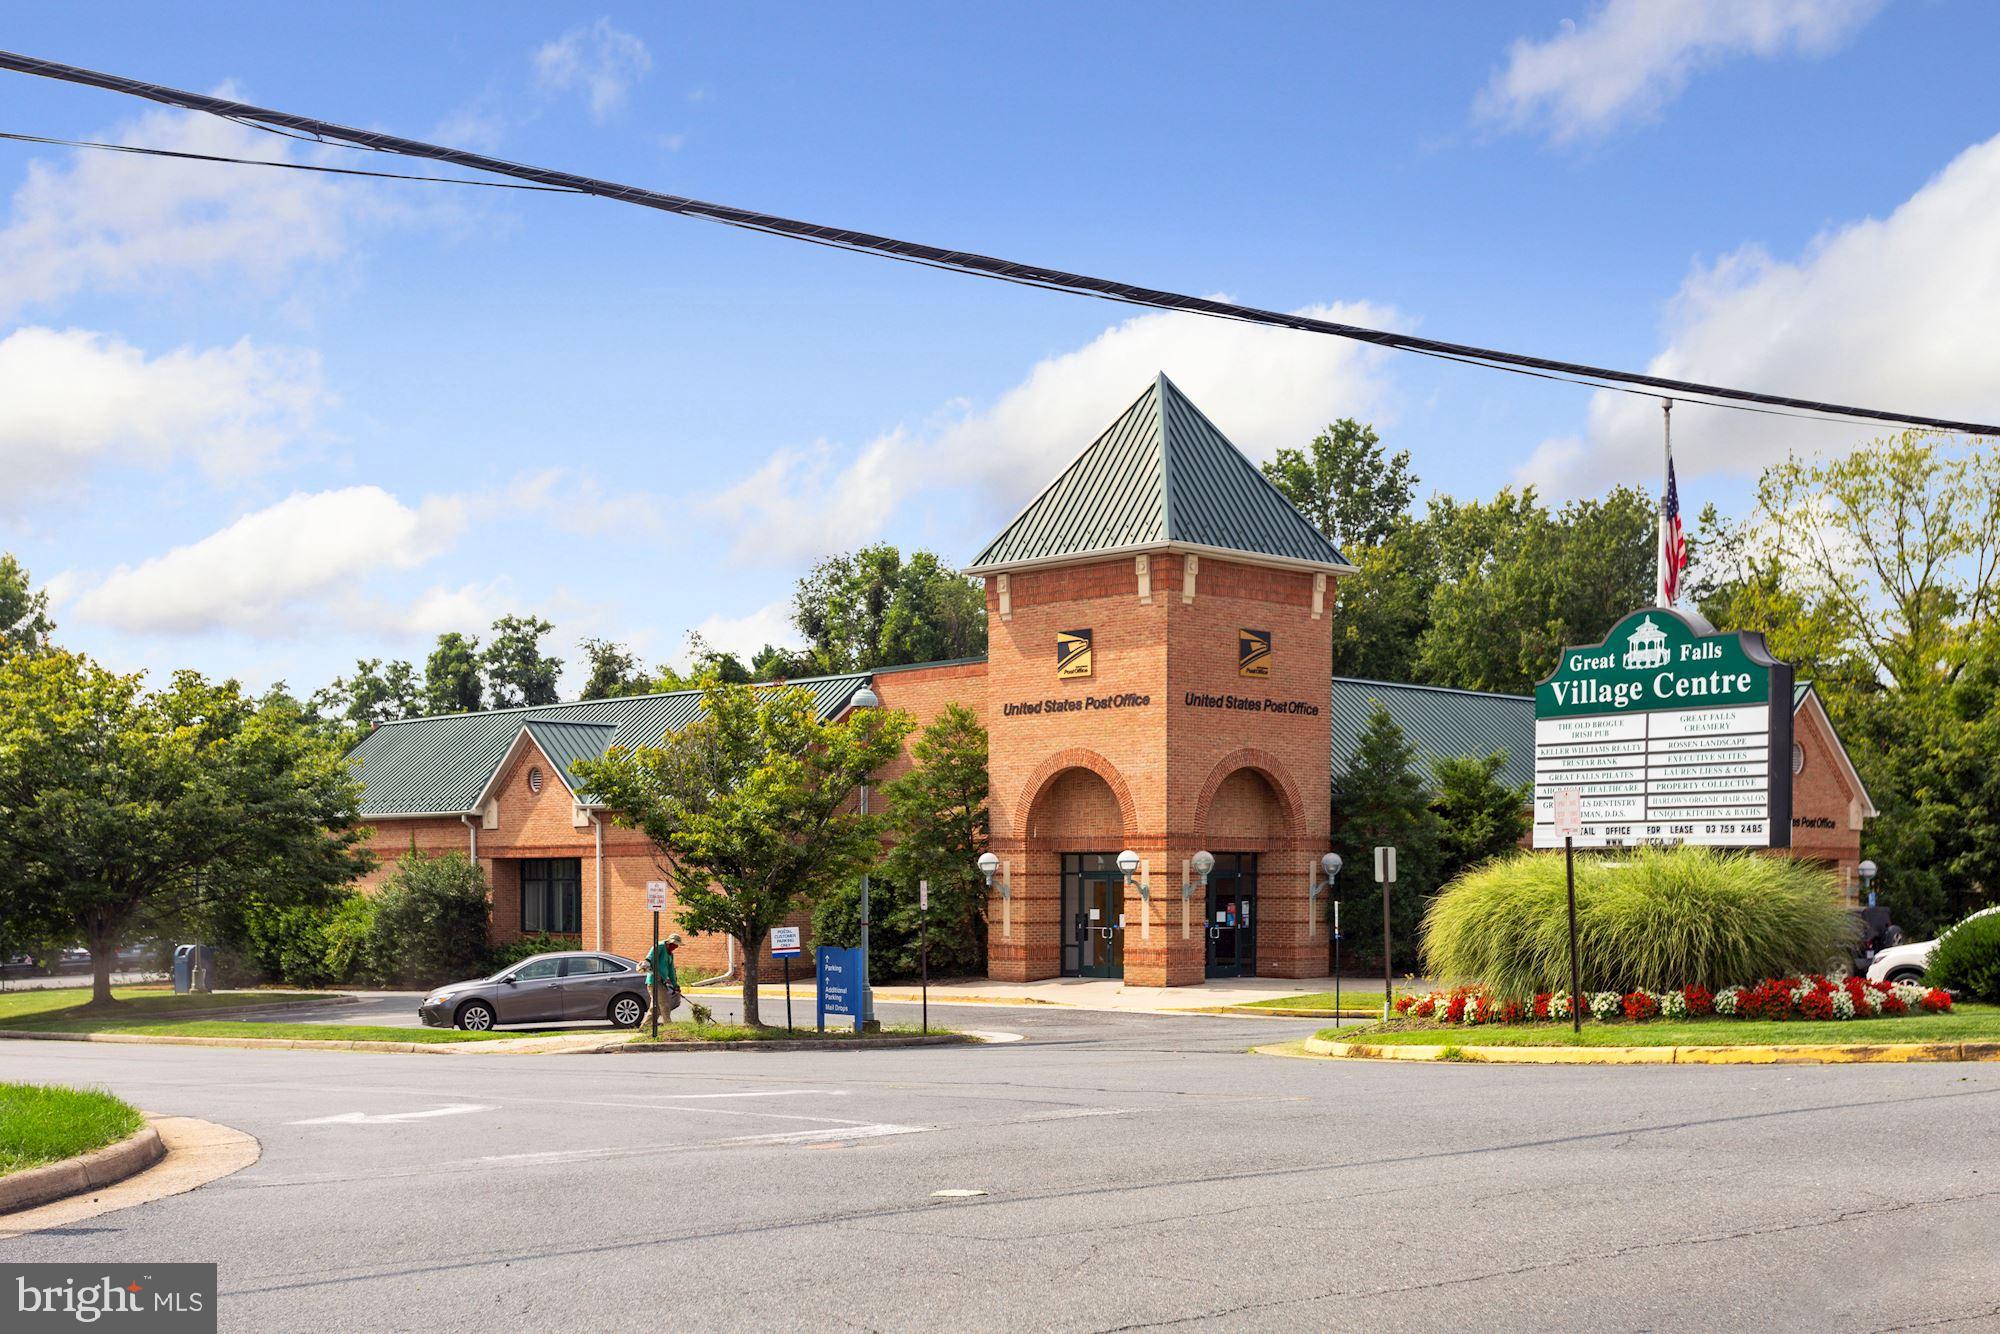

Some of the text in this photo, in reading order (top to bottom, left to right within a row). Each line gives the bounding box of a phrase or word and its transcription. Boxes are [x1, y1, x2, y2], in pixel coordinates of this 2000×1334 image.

[1569, 641, 1722, 672] Great Falls
[1551, 670, 1751, 708] Village Centre
[1003, 693, 1150, 716] United States Post Office
[1185, 692, 1318, 716] United States Post Office
[1680, 712, 1736, 722] GREAT FALLS
[1558, 722, 1572, 730] THE
[1592, 720, 1624, 728] BROGUE
[1684, 722, 1731, 732] CREAMERY
[1572, 731, 1592, 739] IRISH
[1668, 738, 1747, 749] ROSSEN LANDSCAPE
[1540, 744, 1642, 756] KELLER WILLIAMS REALTY
[1667, 752, 1747, 763] EXECUTIVE SUITES
[1562, 759, 1595, 767] TRUSTAR
[1549, 771, 1634, 781] GREAT FALLS PILATES
[1664, 767, 1697, 776] LAUREN
[1588, 784, 1640, 793] HEALTHCARE
[1656, 779, 1757, 790] PROPERTY COLLECTIVE
[1593, 799, 1636, 807] DENTISTRY
[1689, 796, 1721, 804] ORGANIC
[1742, 794, 1766, 802] SALON
[1653, 809, 1683, 818] UNIQUE
[1686, 808, 1723, 817] KITCHEN
[1734, 807, 1761, 816] BATHS
[1801, 817, 1816, 828] Post
[1816, 817, 1835, 829] Office
[1605, 826, 1631, 835] OFFICE
[1647, 826, 1661, 834] FOR
[1670, 825, 1693, 834] LEASE
[1706, 825, 1716, 833] 03
[1720, 824, 1735, 833] 759
[825, 964, 842, 973] Parking
[825, 986, 847, 994] Additional
[825, 993, 842, 1002] Parking
[835, 1004, 849, 1012] Drops
